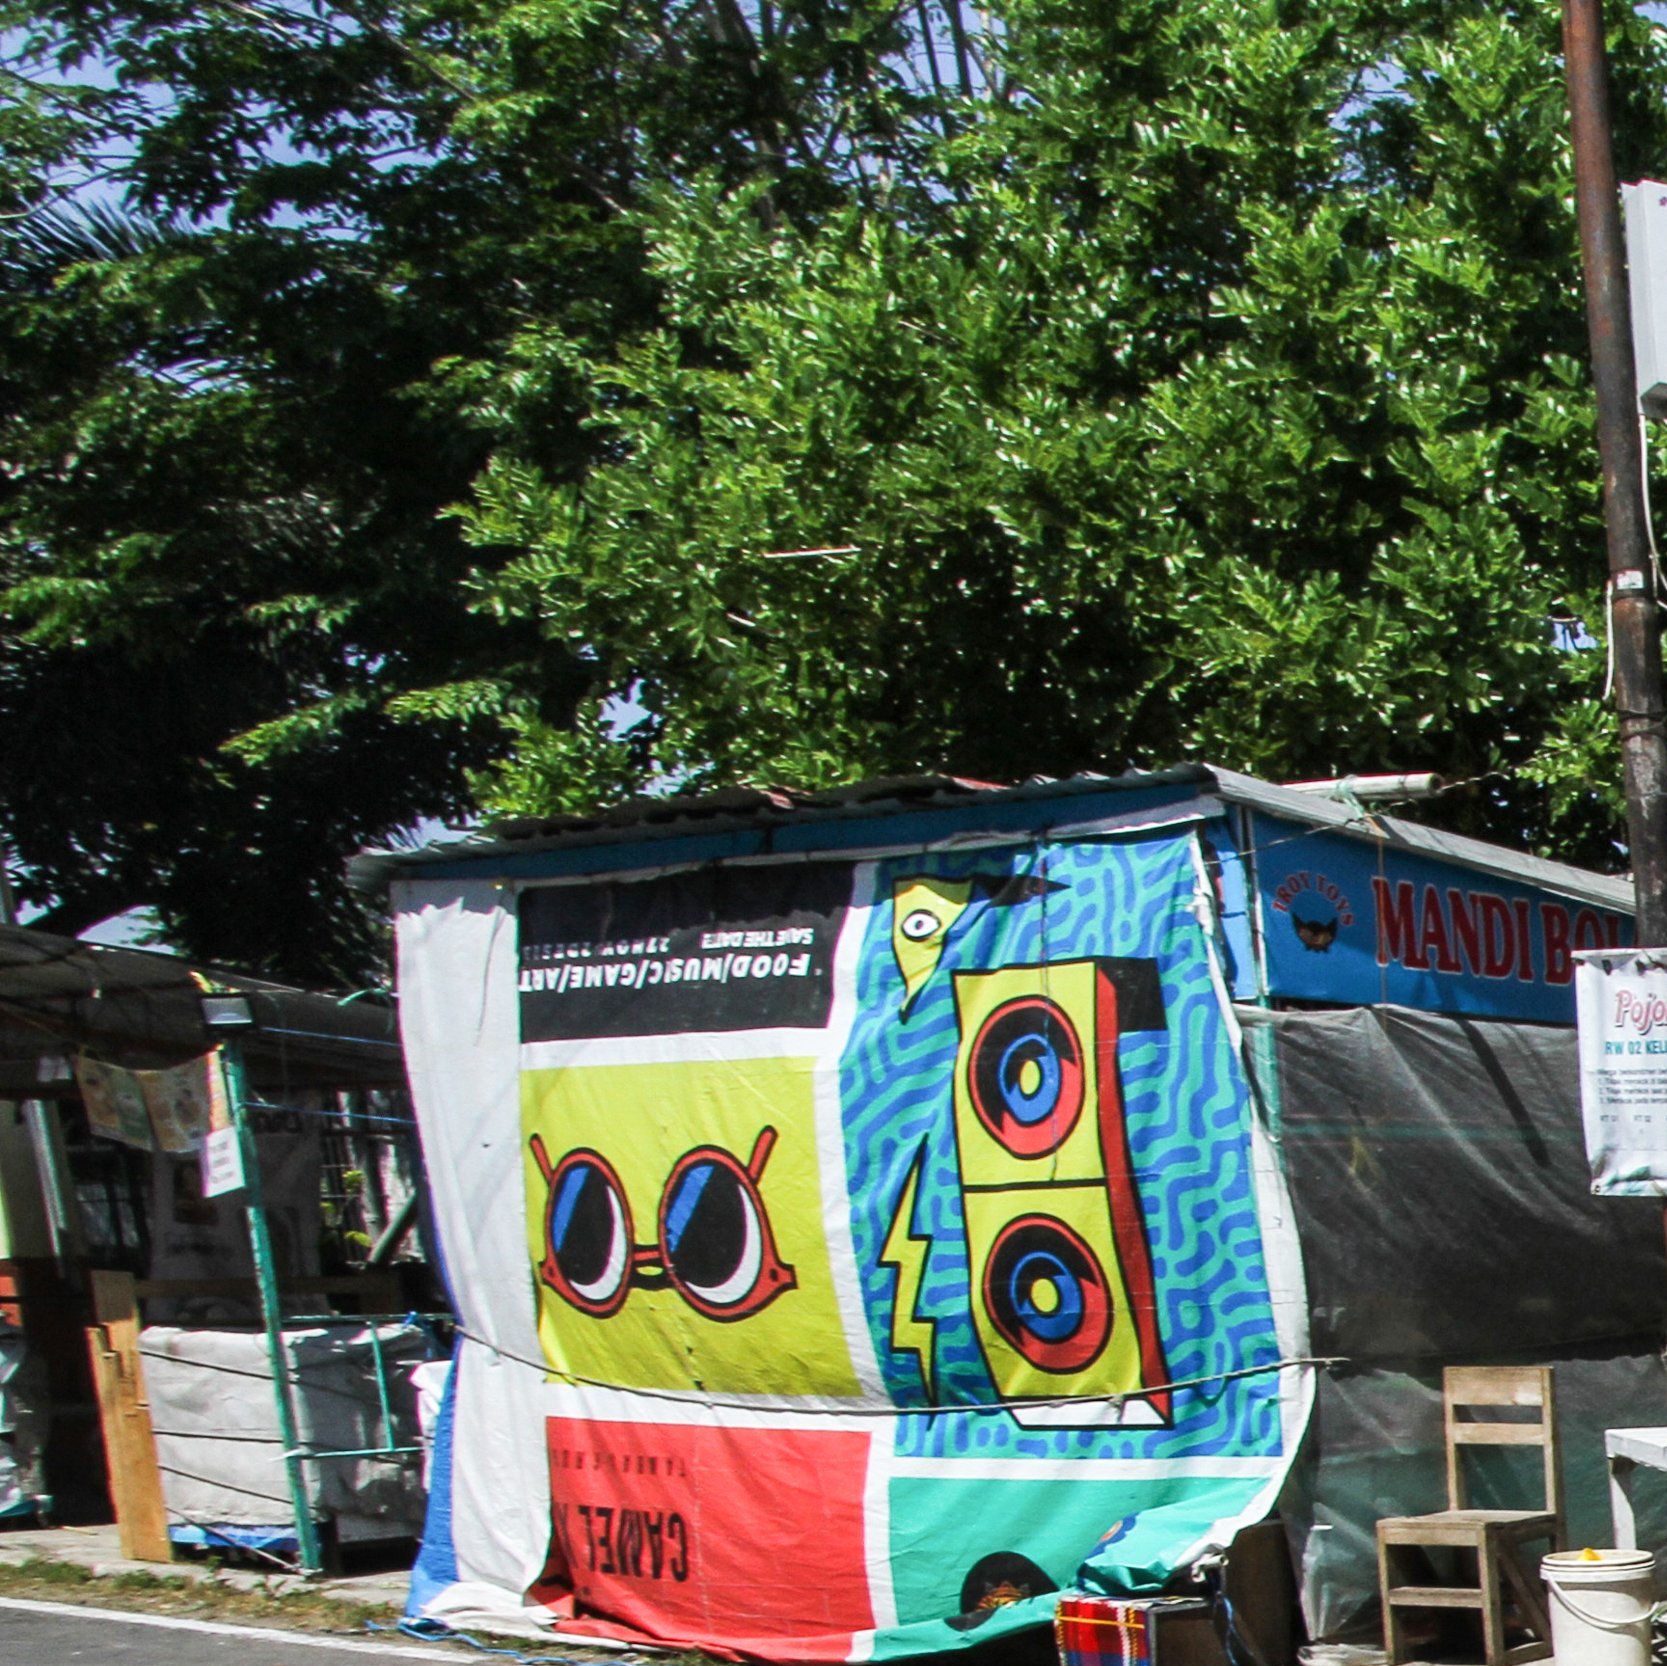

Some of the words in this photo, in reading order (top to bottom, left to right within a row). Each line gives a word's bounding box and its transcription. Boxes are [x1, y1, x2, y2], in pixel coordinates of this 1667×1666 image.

[1372, 876, 1534, 982] MANDI
[1605, 1040, 1624, 1055] RW
[1628, 1040, 1642, 1055] 02
[577, 1504, 689, 1582] CAMEL
